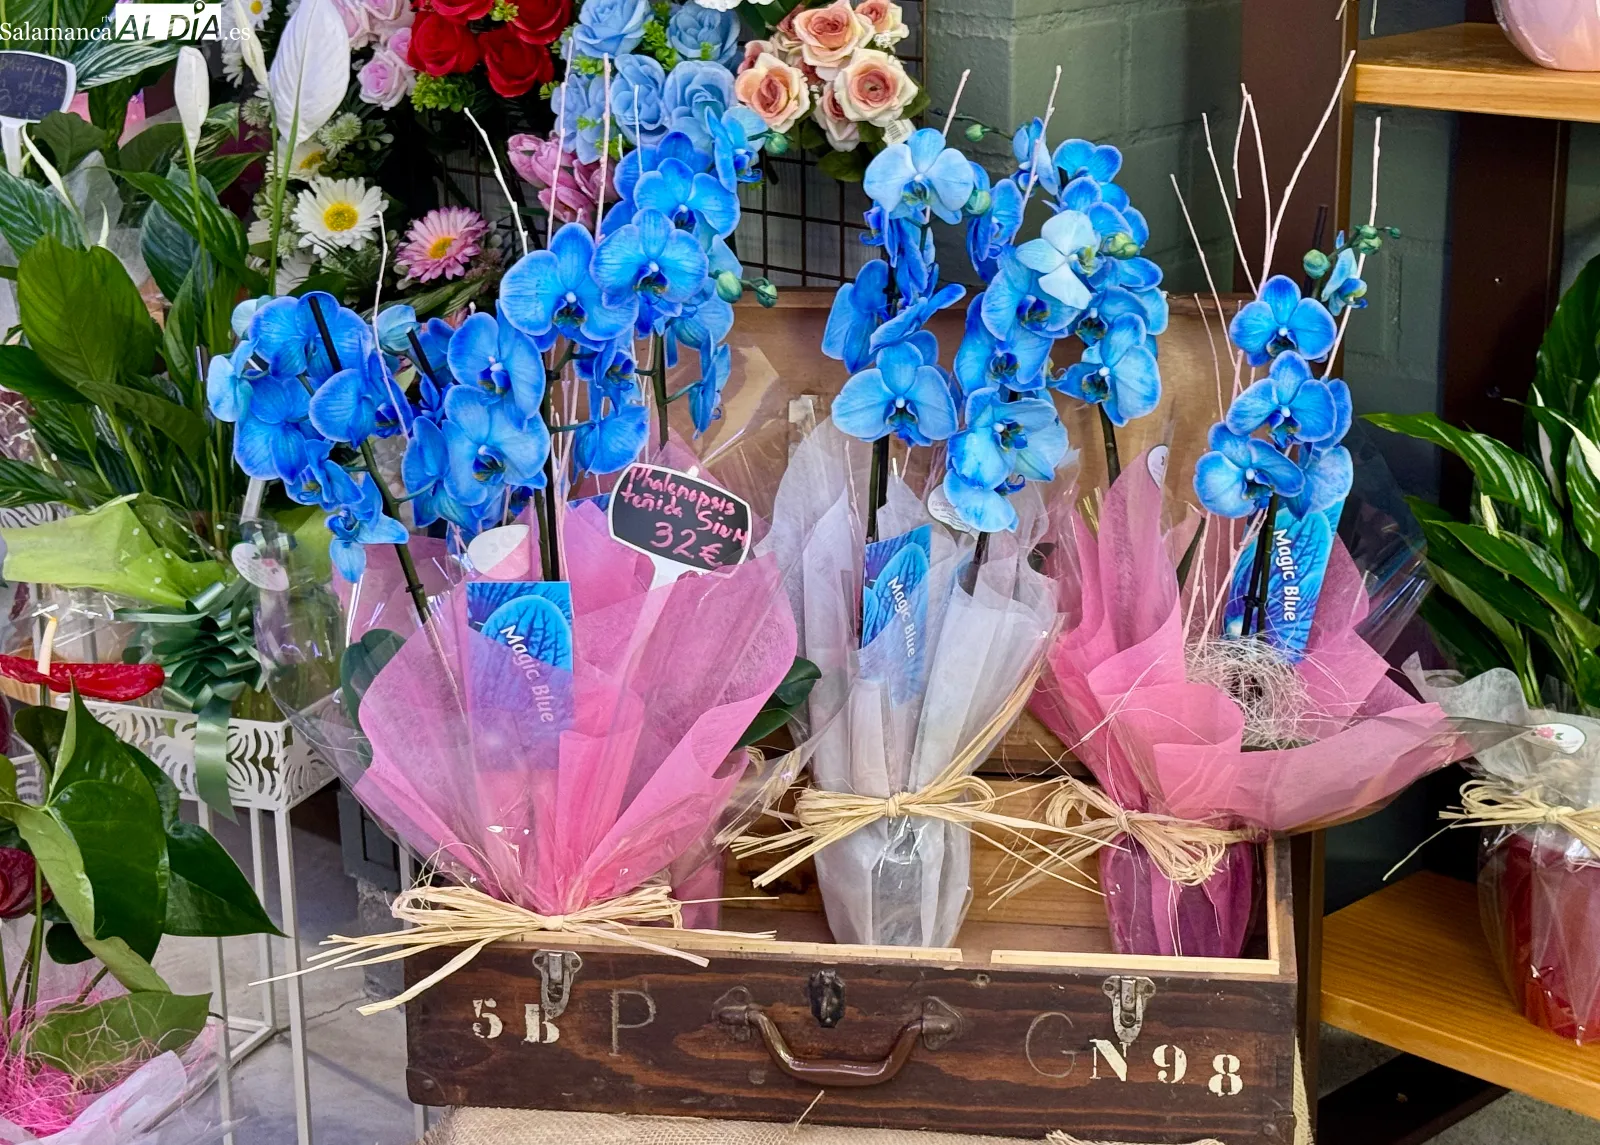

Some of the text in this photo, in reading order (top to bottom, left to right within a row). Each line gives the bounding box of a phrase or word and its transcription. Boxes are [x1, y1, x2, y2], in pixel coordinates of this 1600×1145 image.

[888, 575, 916, 658] Magic Blue
[1272, 528, 1300, 622] Magic Blue
[500, 624, 554, 724] Magic Blue
